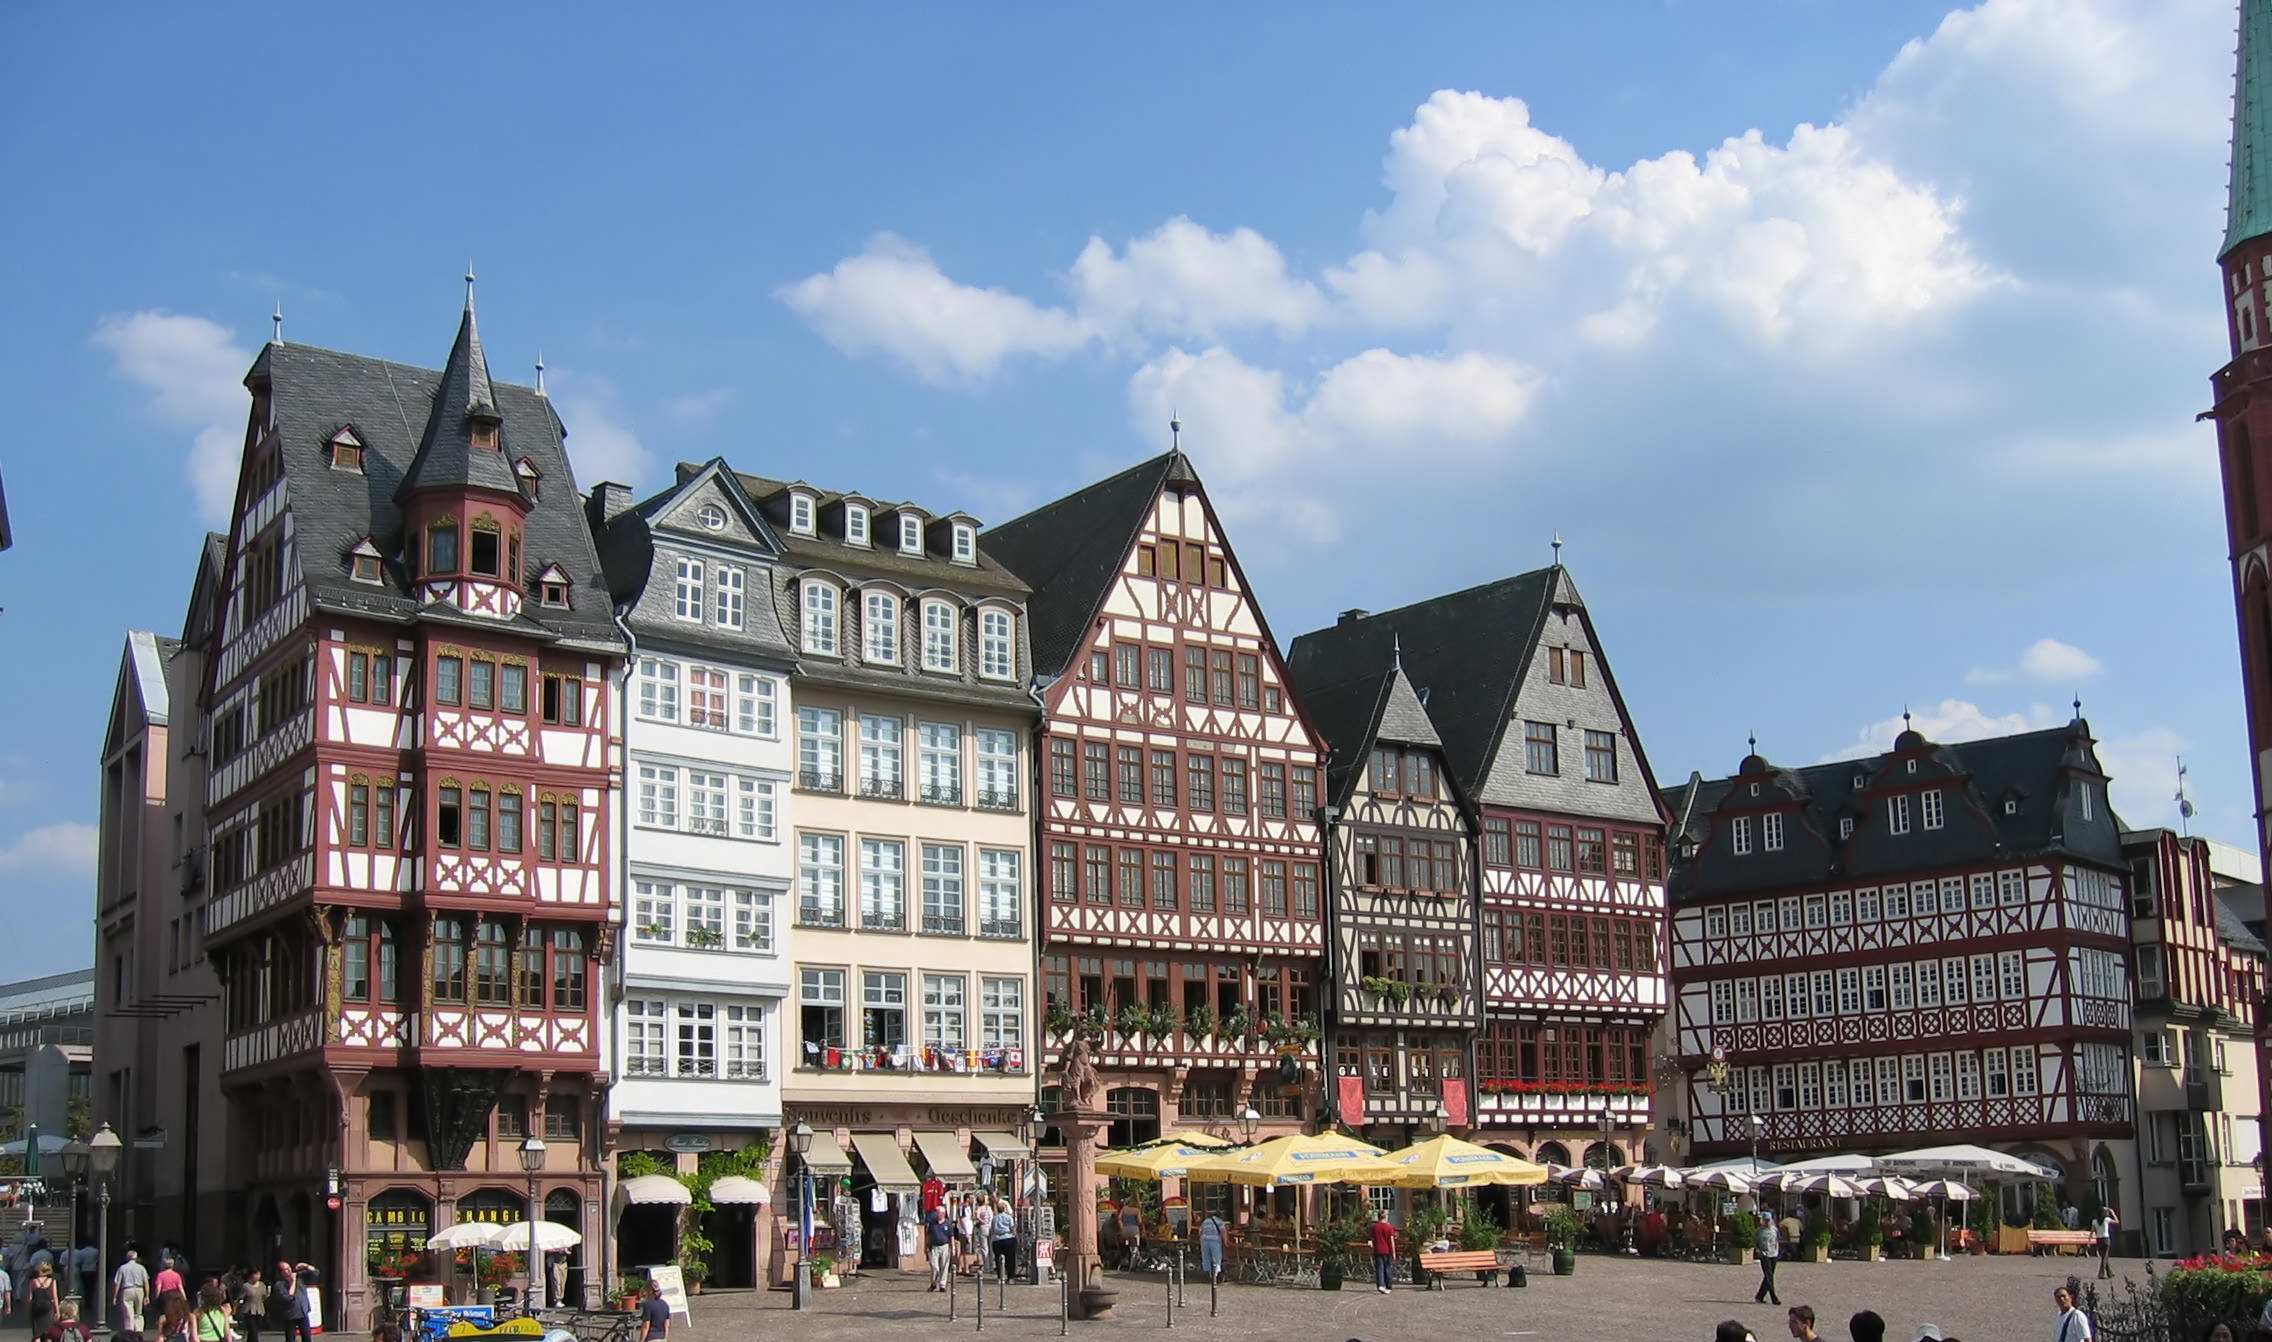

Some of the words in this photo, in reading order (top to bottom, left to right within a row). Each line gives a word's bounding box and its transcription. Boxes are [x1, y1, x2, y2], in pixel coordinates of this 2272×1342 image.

[1338, 1066, 1449, 1078] GALERIE
[928, 1106, 1018, 1124] Geschenke
[1769, 1138, 1841, 1151] RESTAURANT
[367, 1210, 426, 1224] CAMBIO
[456, 1209, 521, 1222] CHANGE
